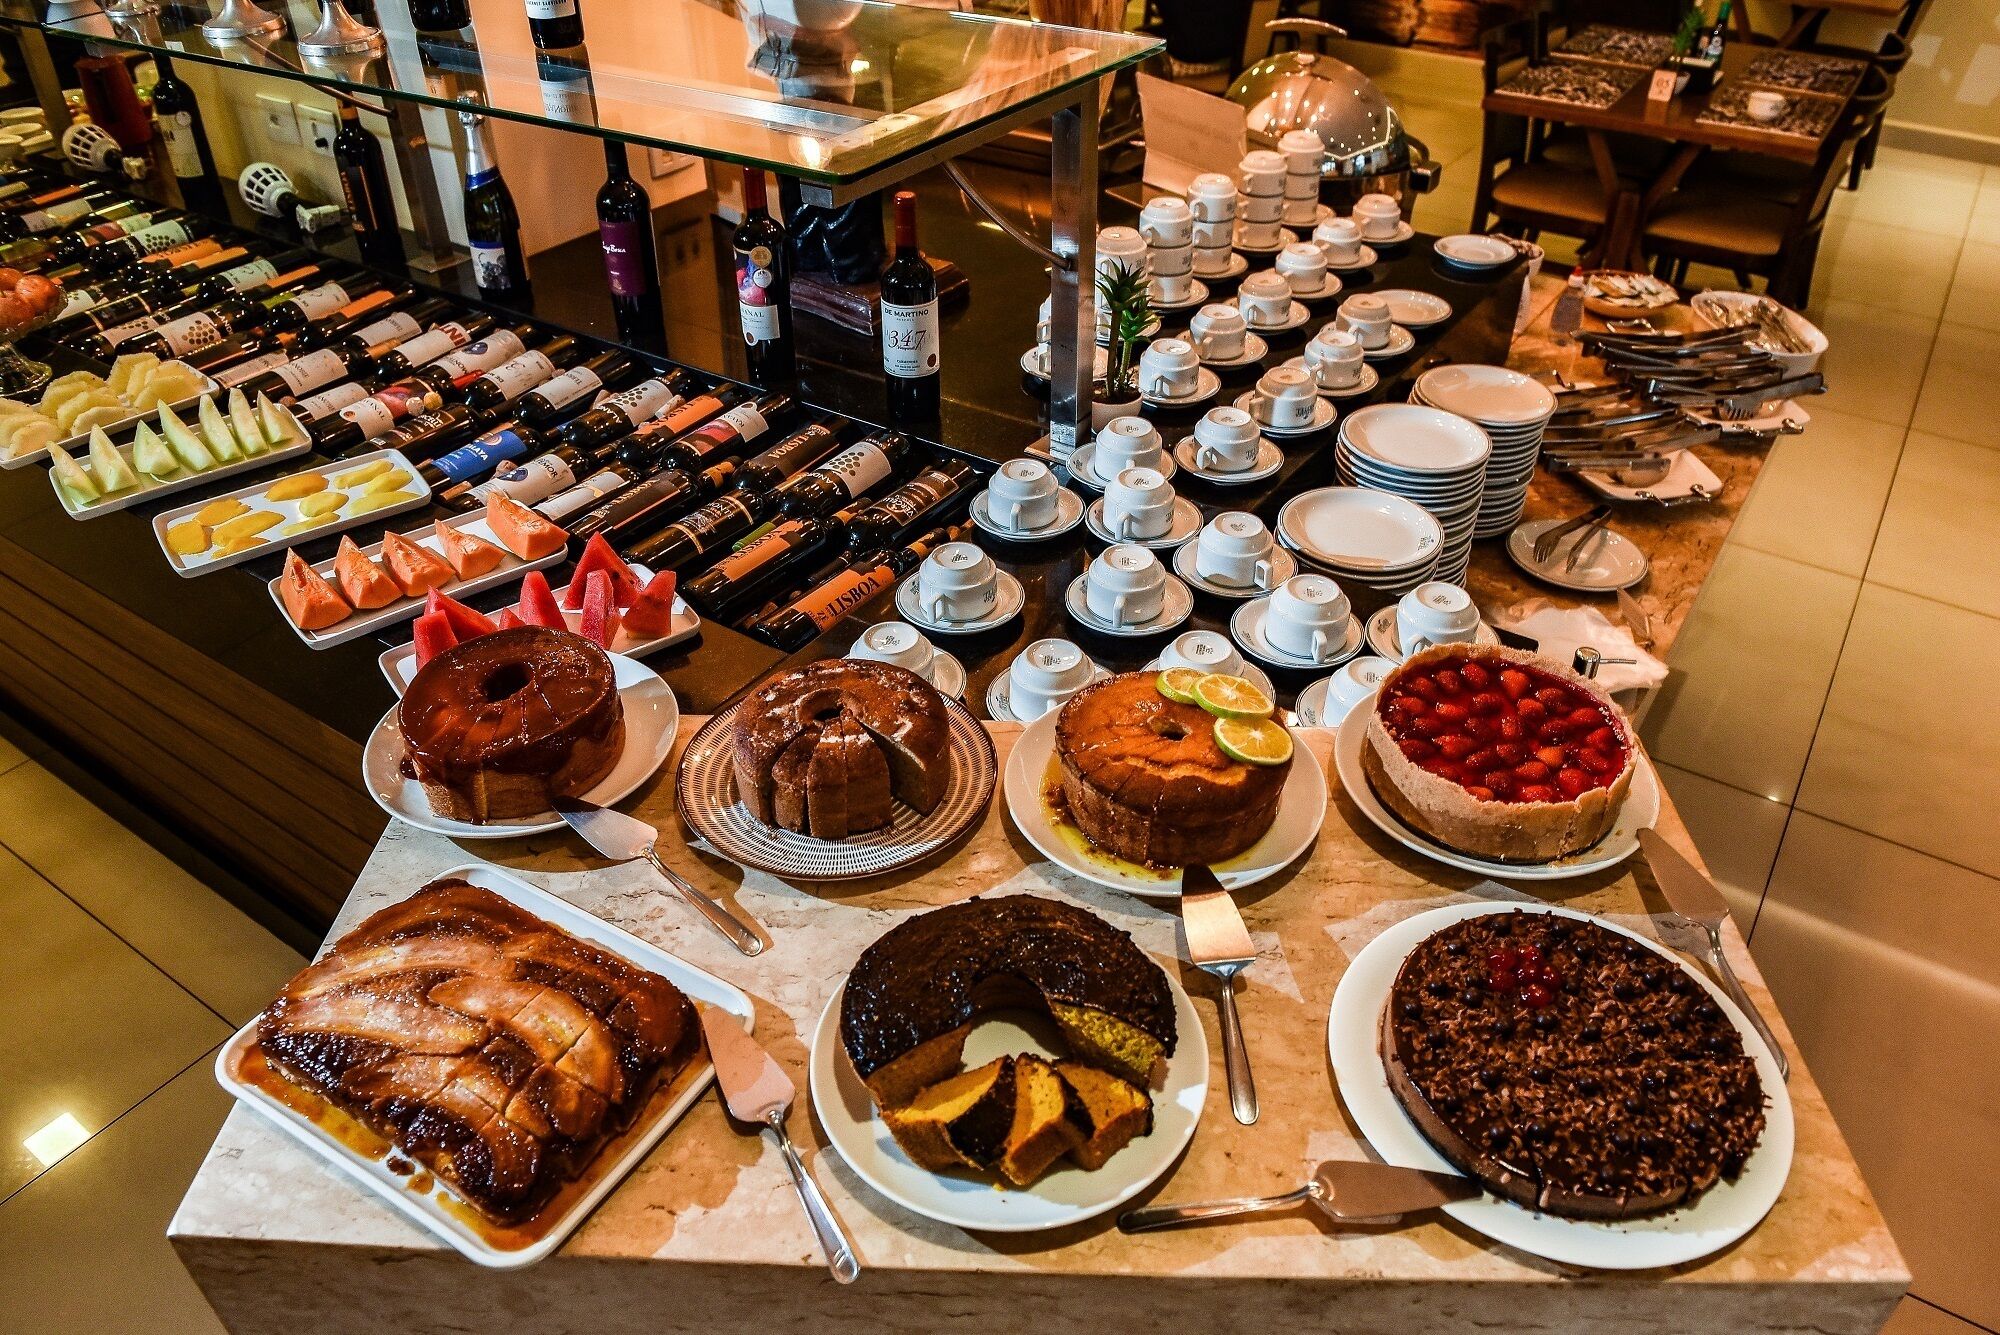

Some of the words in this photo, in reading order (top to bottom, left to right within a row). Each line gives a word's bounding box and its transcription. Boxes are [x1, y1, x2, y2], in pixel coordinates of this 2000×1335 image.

[885, 308, 893, 316] DE
[894, 309, 930, 318] MARTINO
[888, 329, 927, 350] 347
[827, 576, 881, 617] LISBOA
